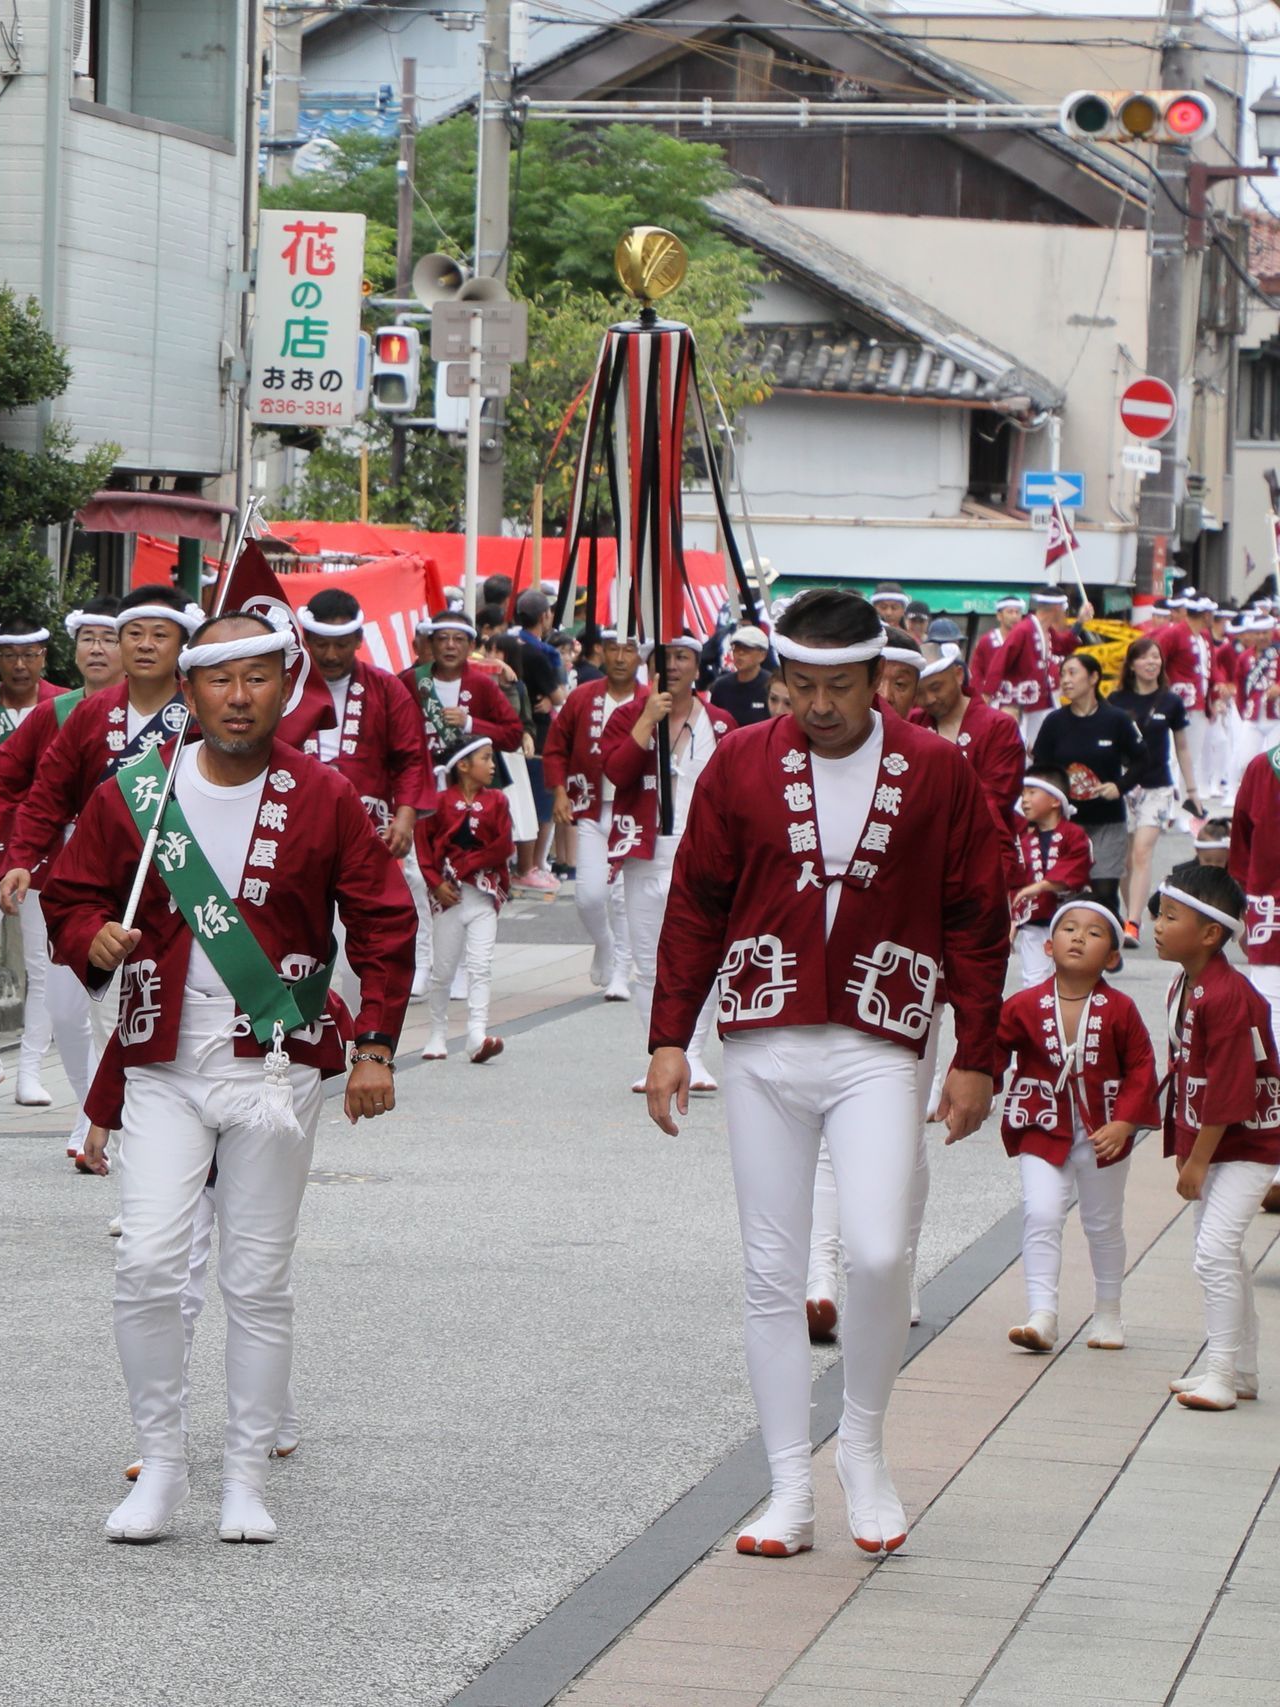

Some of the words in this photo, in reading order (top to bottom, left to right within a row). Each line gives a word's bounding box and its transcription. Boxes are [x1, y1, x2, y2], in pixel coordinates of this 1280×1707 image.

[281, 220, 338, 359] 花の店
[262, 366, 343, 392] おおの
[131, 775, 239, 940] 交渉係
[241, 799, 288, 907] 紙屋町
[783, 782, 824, 892] 世話人
[848, 783, 902, 889] 紙屋町
[1085, 1015, 1102, 1065] 紙屋町
